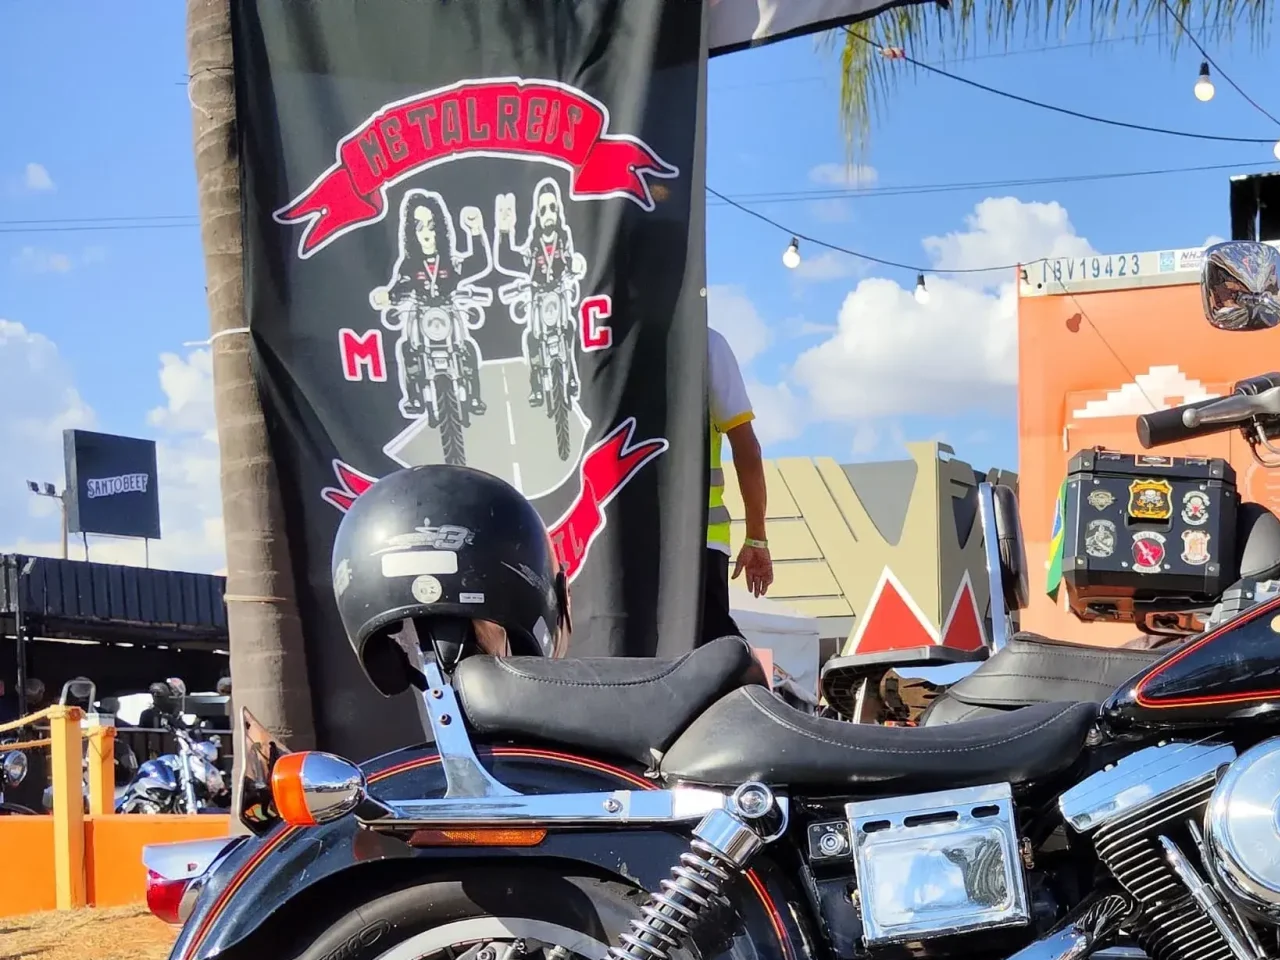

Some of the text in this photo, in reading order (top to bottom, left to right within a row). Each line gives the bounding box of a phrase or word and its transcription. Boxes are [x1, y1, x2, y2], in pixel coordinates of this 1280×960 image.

[340, 296, 612, 382] M C
[86, 473, 149, 499] SANTOBEEF
